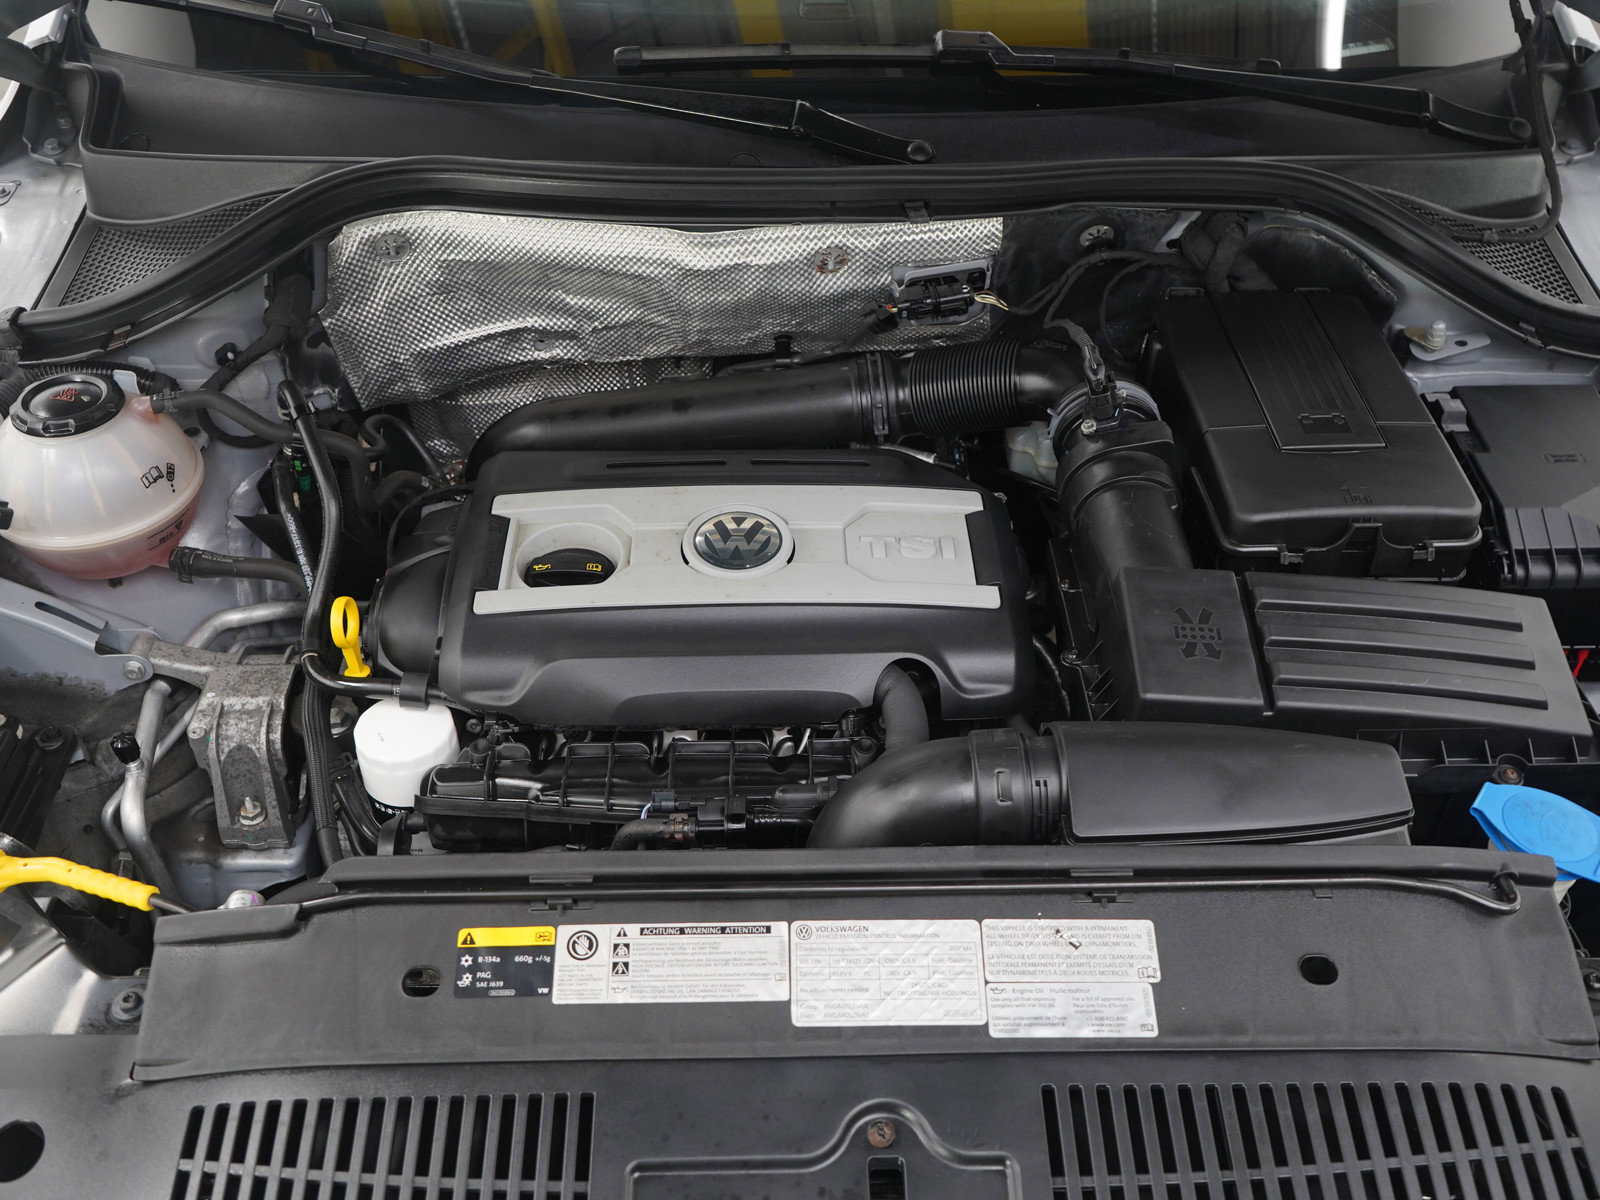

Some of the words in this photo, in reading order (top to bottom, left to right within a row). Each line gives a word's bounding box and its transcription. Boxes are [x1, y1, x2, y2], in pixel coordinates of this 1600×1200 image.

[159, 531, 174, 545] min
[859, 535, 956, 560] TSI
[514, 955, 533, 964] 660g
